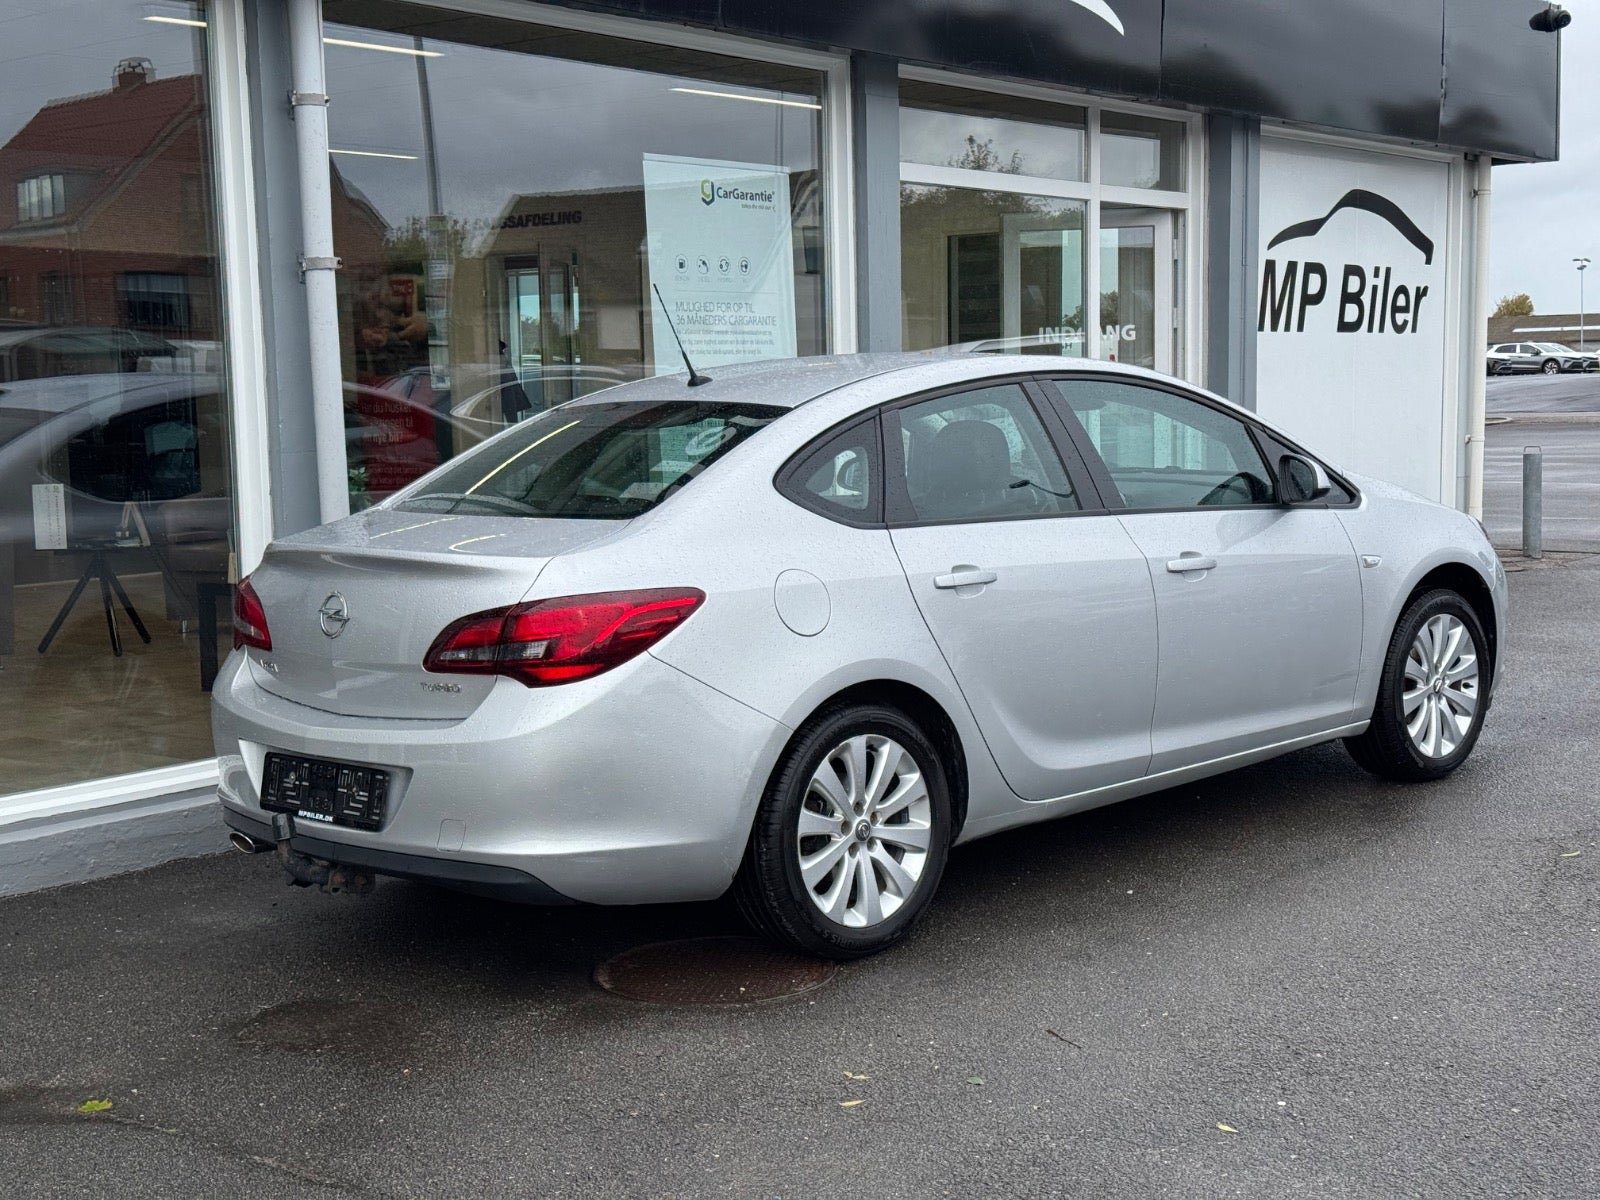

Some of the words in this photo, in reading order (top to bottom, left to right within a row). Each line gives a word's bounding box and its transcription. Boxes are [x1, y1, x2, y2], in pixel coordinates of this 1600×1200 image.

[716, 187, 773, 202] CarGarantie
[1257, 259, 1328, 332] MP
[1336, 264, 1429, 335] Biler
[717, 302, 731, 312] FOR
[733, 302, 743, 312] OP
[745, 303, 754, 313] TIL
[676, 315, 685, 325] 36
